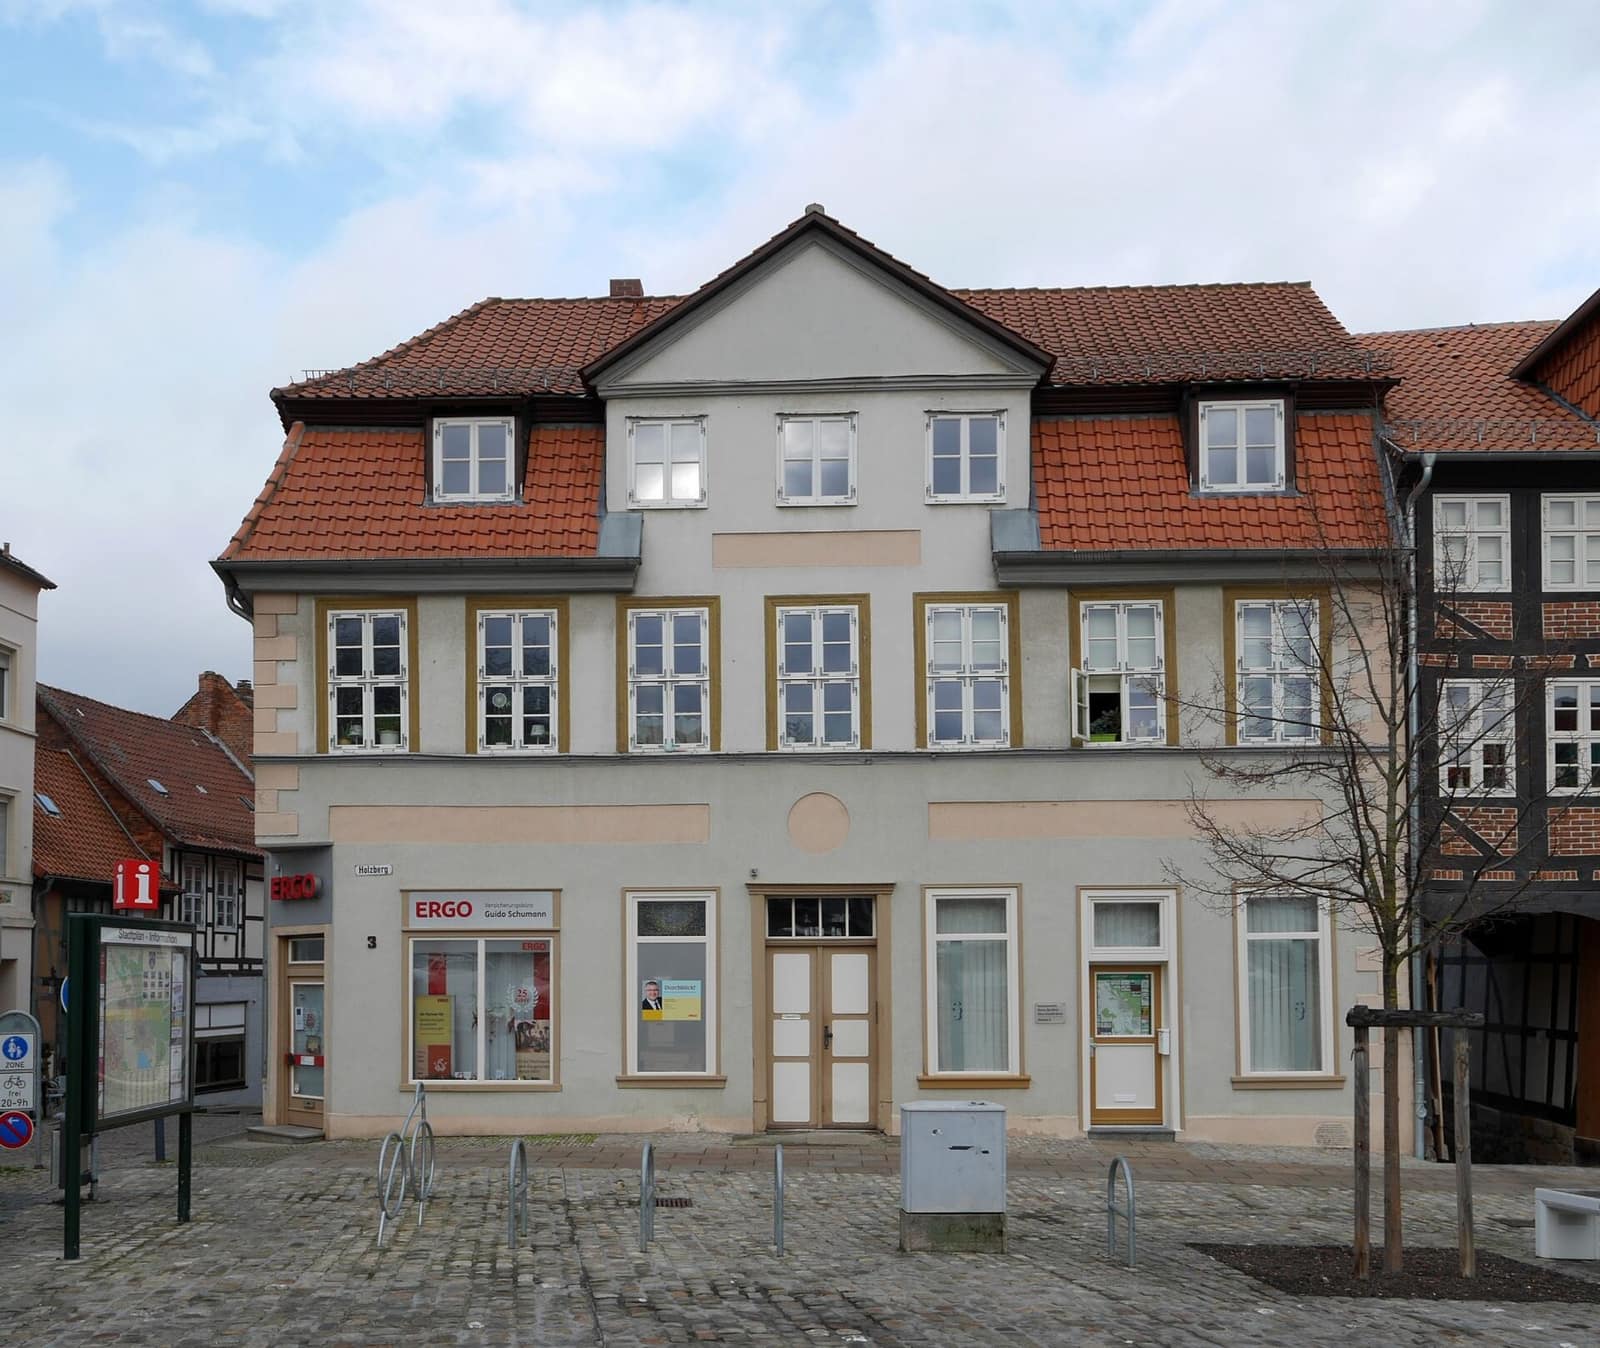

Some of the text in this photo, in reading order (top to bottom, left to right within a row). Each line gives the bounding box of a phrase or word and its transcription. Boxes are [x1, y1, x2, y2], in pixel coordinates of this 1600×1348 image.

[358, 865, 389, 875] Holzberg
[271, 873, 316, 901] ERGO
[415, 901, 473, 918] ERGO
[484, 910, 547, 918] Guido Schumann
[367, 936, 377, 949] 3
[517, 988, 528, 997] 25
[5, 1061, 25, 1069] ZONE
